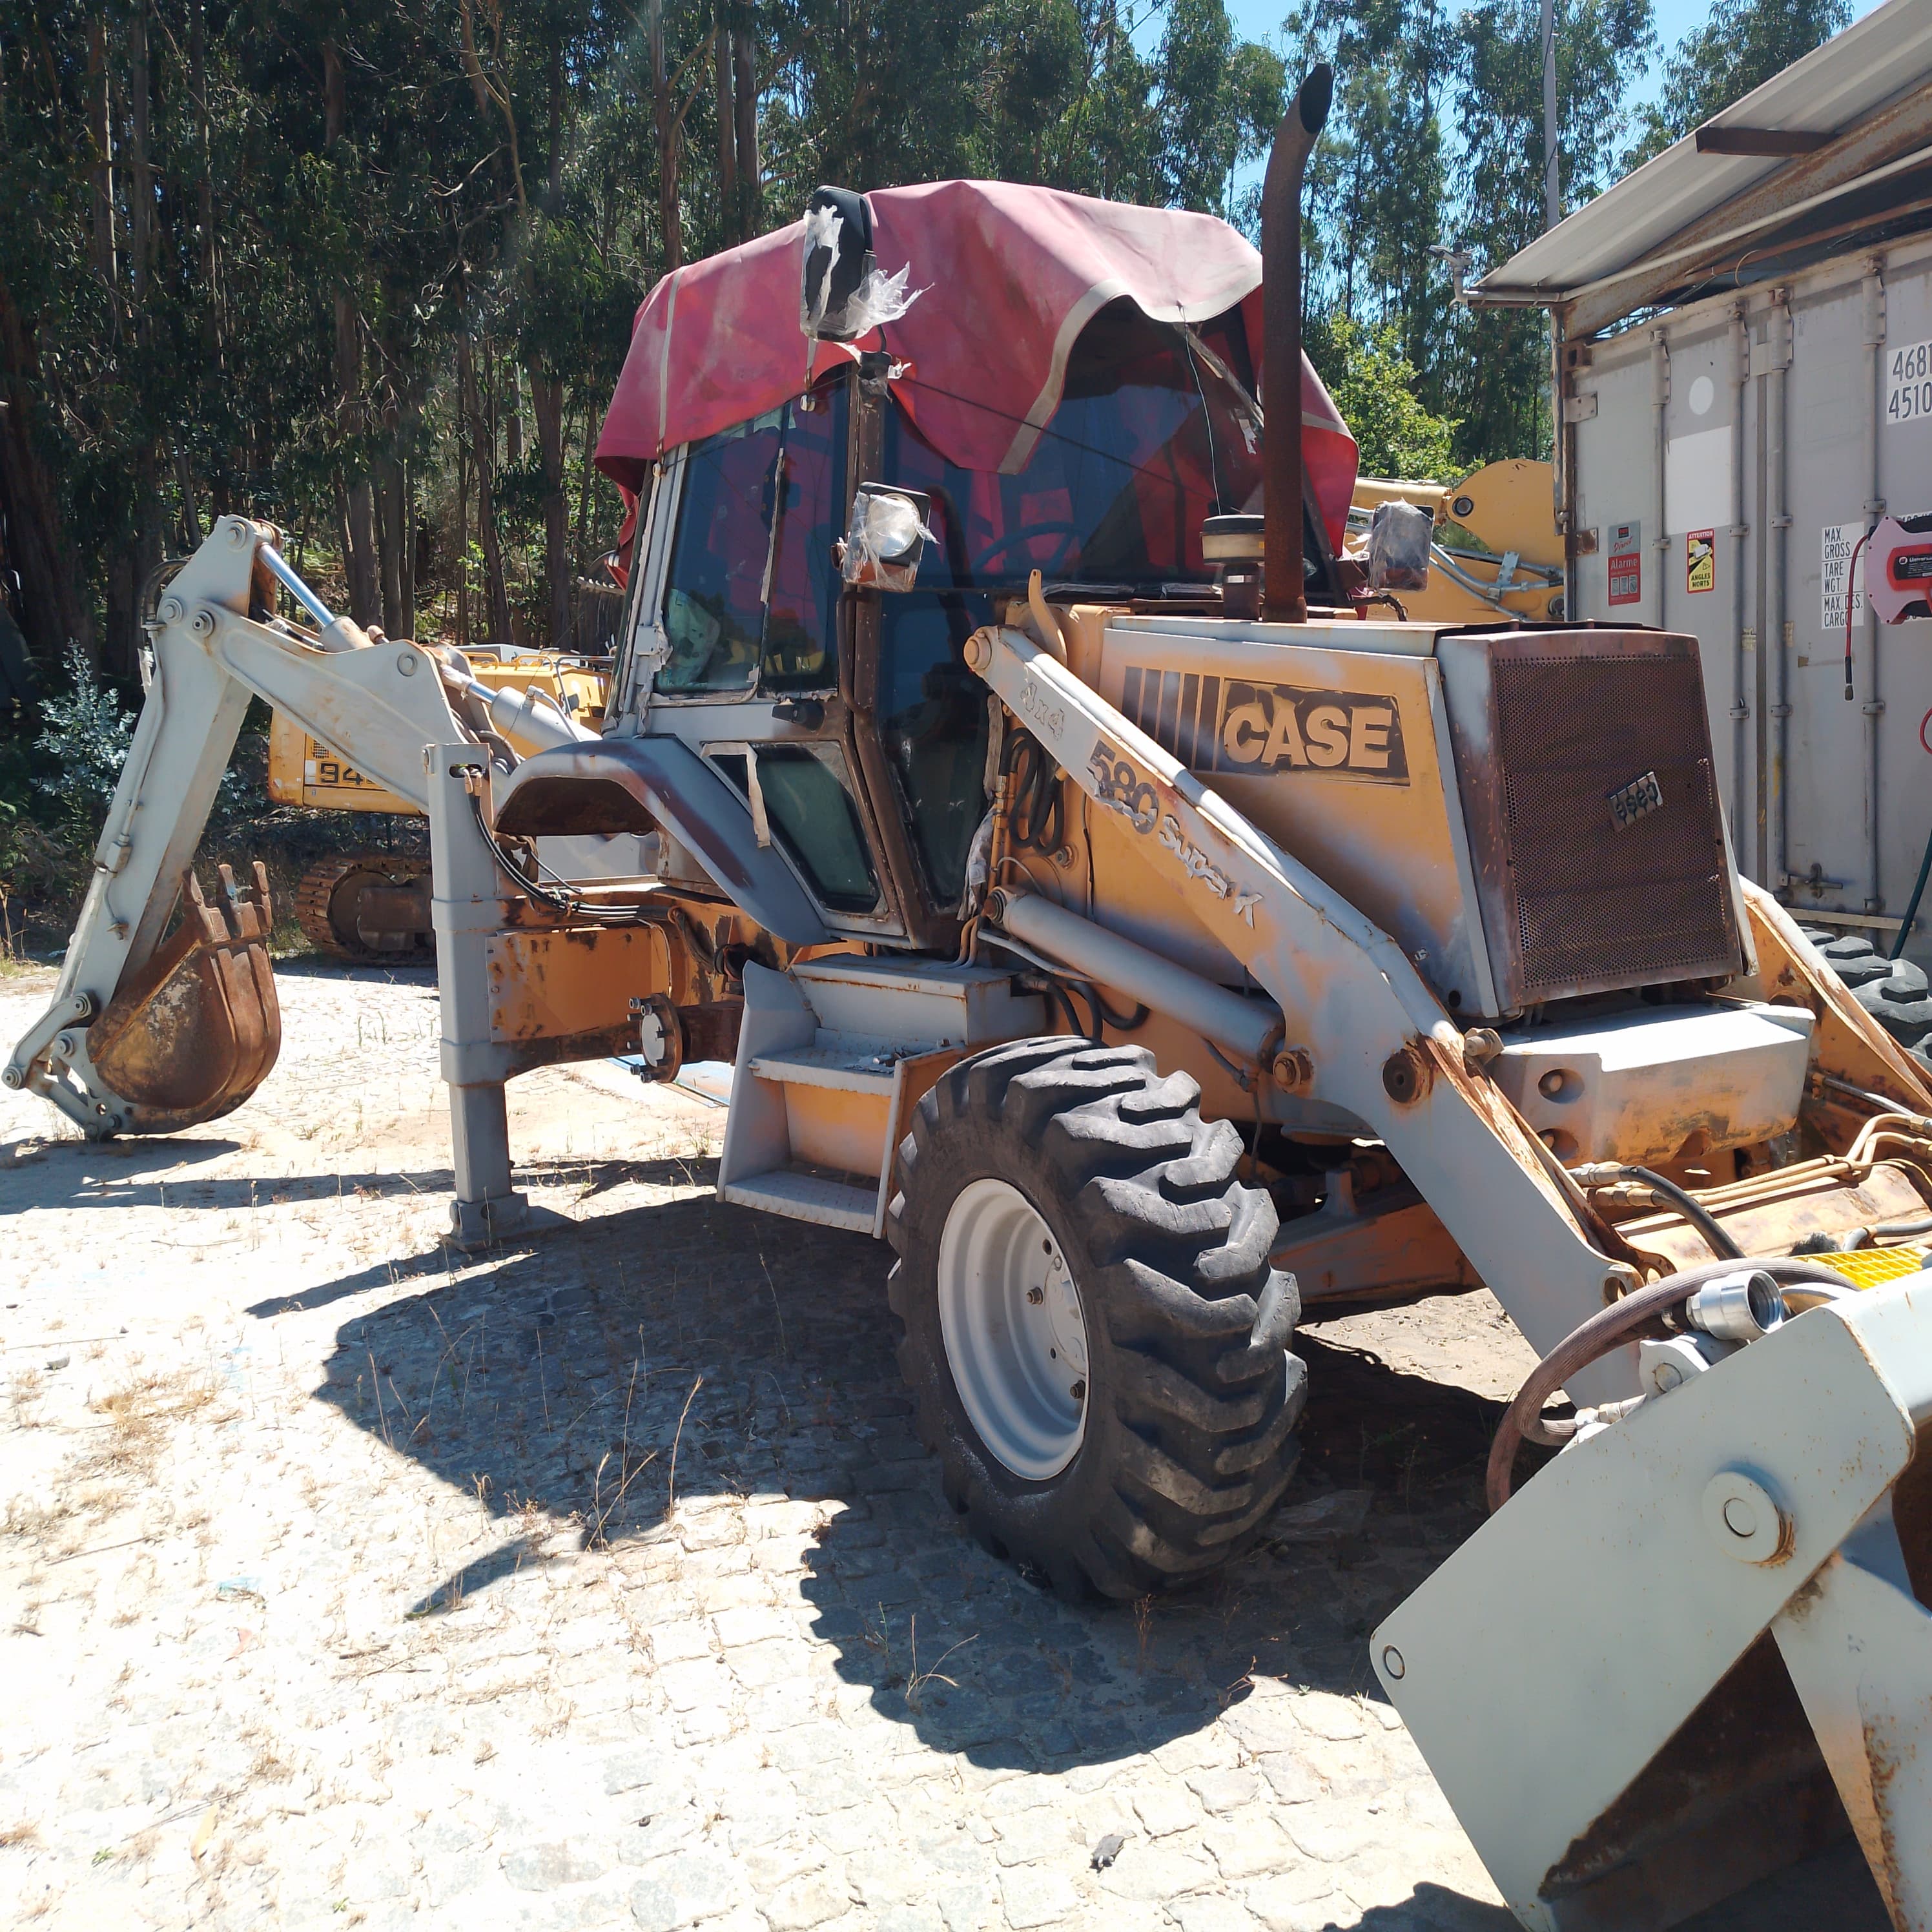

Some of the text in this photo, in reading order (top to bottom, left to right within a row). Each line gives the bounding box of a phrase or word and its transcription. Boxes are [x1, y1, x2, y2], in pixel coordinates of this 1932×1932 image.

[1689, 530, 1713, 539] ATTENTION
[1824, 527, 1844, 544] MAX.
[1824, 542, 1850, 559] GROSS
[1611, 559, 1638, 570] Alarme
[1824, 561, 1844, 578] TARE
[1691, 573, 1711, 581] ANGLES
[1824, 577, 1842, 593] WGT.
[1824, 595, 1843, 611] MAX.
[1224, 703, 1392, 768] CASE
[320, 763, 375, 785] 94
[1087, 739, 1160, 834] 580
